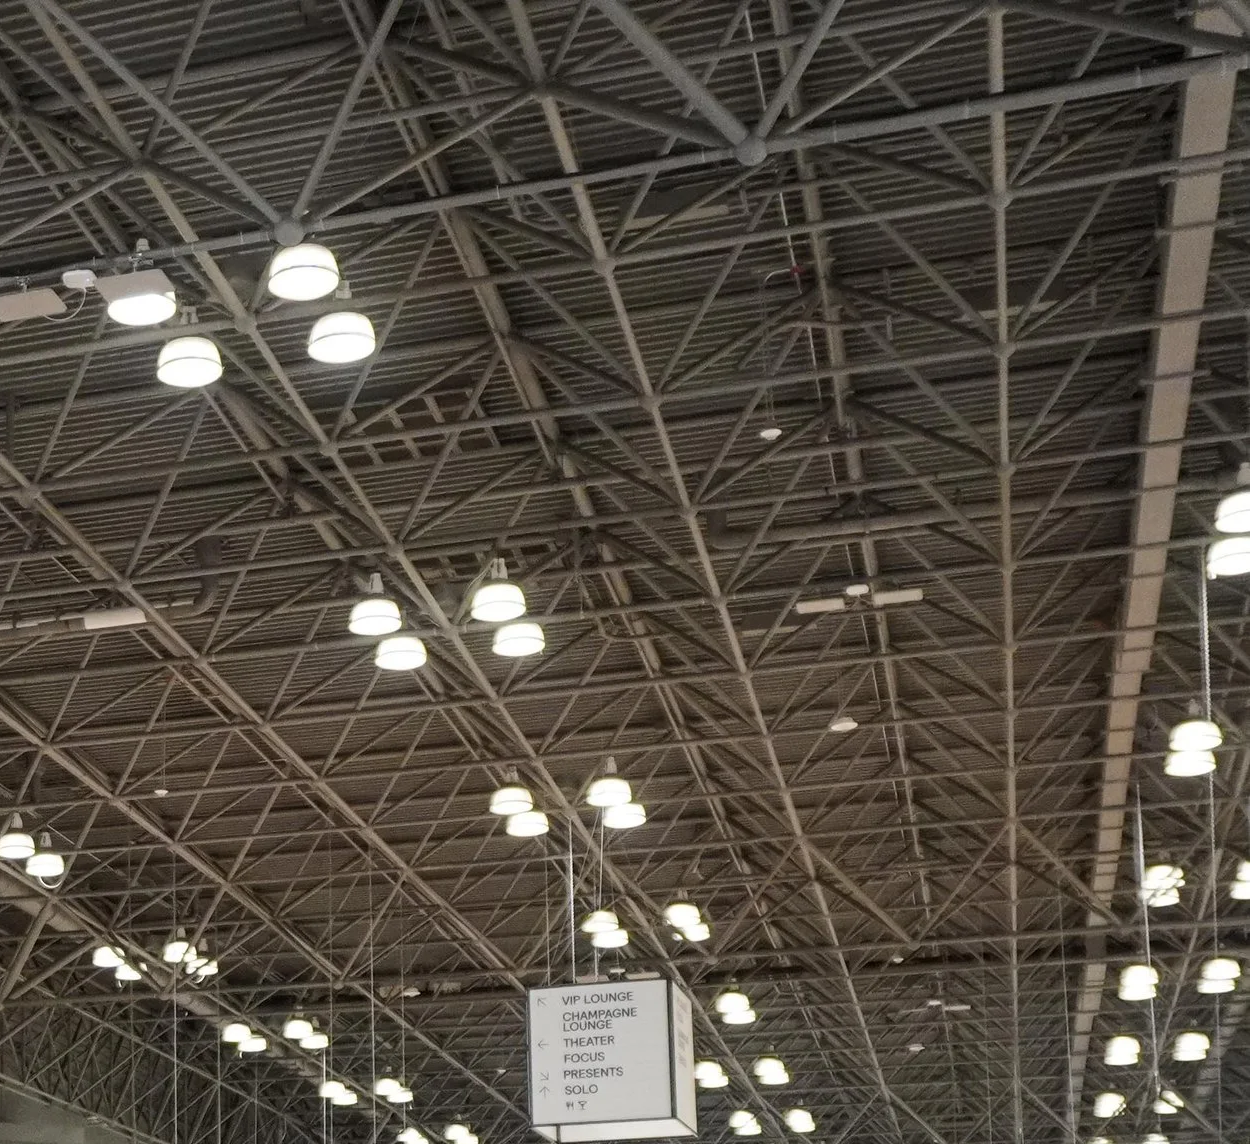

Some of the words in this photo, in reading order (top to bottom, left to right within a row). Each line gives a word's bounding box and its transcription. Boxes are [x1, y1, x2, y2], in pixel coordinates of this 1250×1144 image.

[561, 995, 581, 1006] VIP
[584, 992, 634, 1004] LOUNGE
[562, 1007, 638, 1021] CHAMPAGNE
[562, 1019, 613, 1032] LOUNGE
[563, 1035, 615, 1048] THEATER
[563, 1051, 605, 1064] FOCUS
[563, 1066, 624, 1080] PRESENTS
[564, 1084, 599, 1096] SOLO
